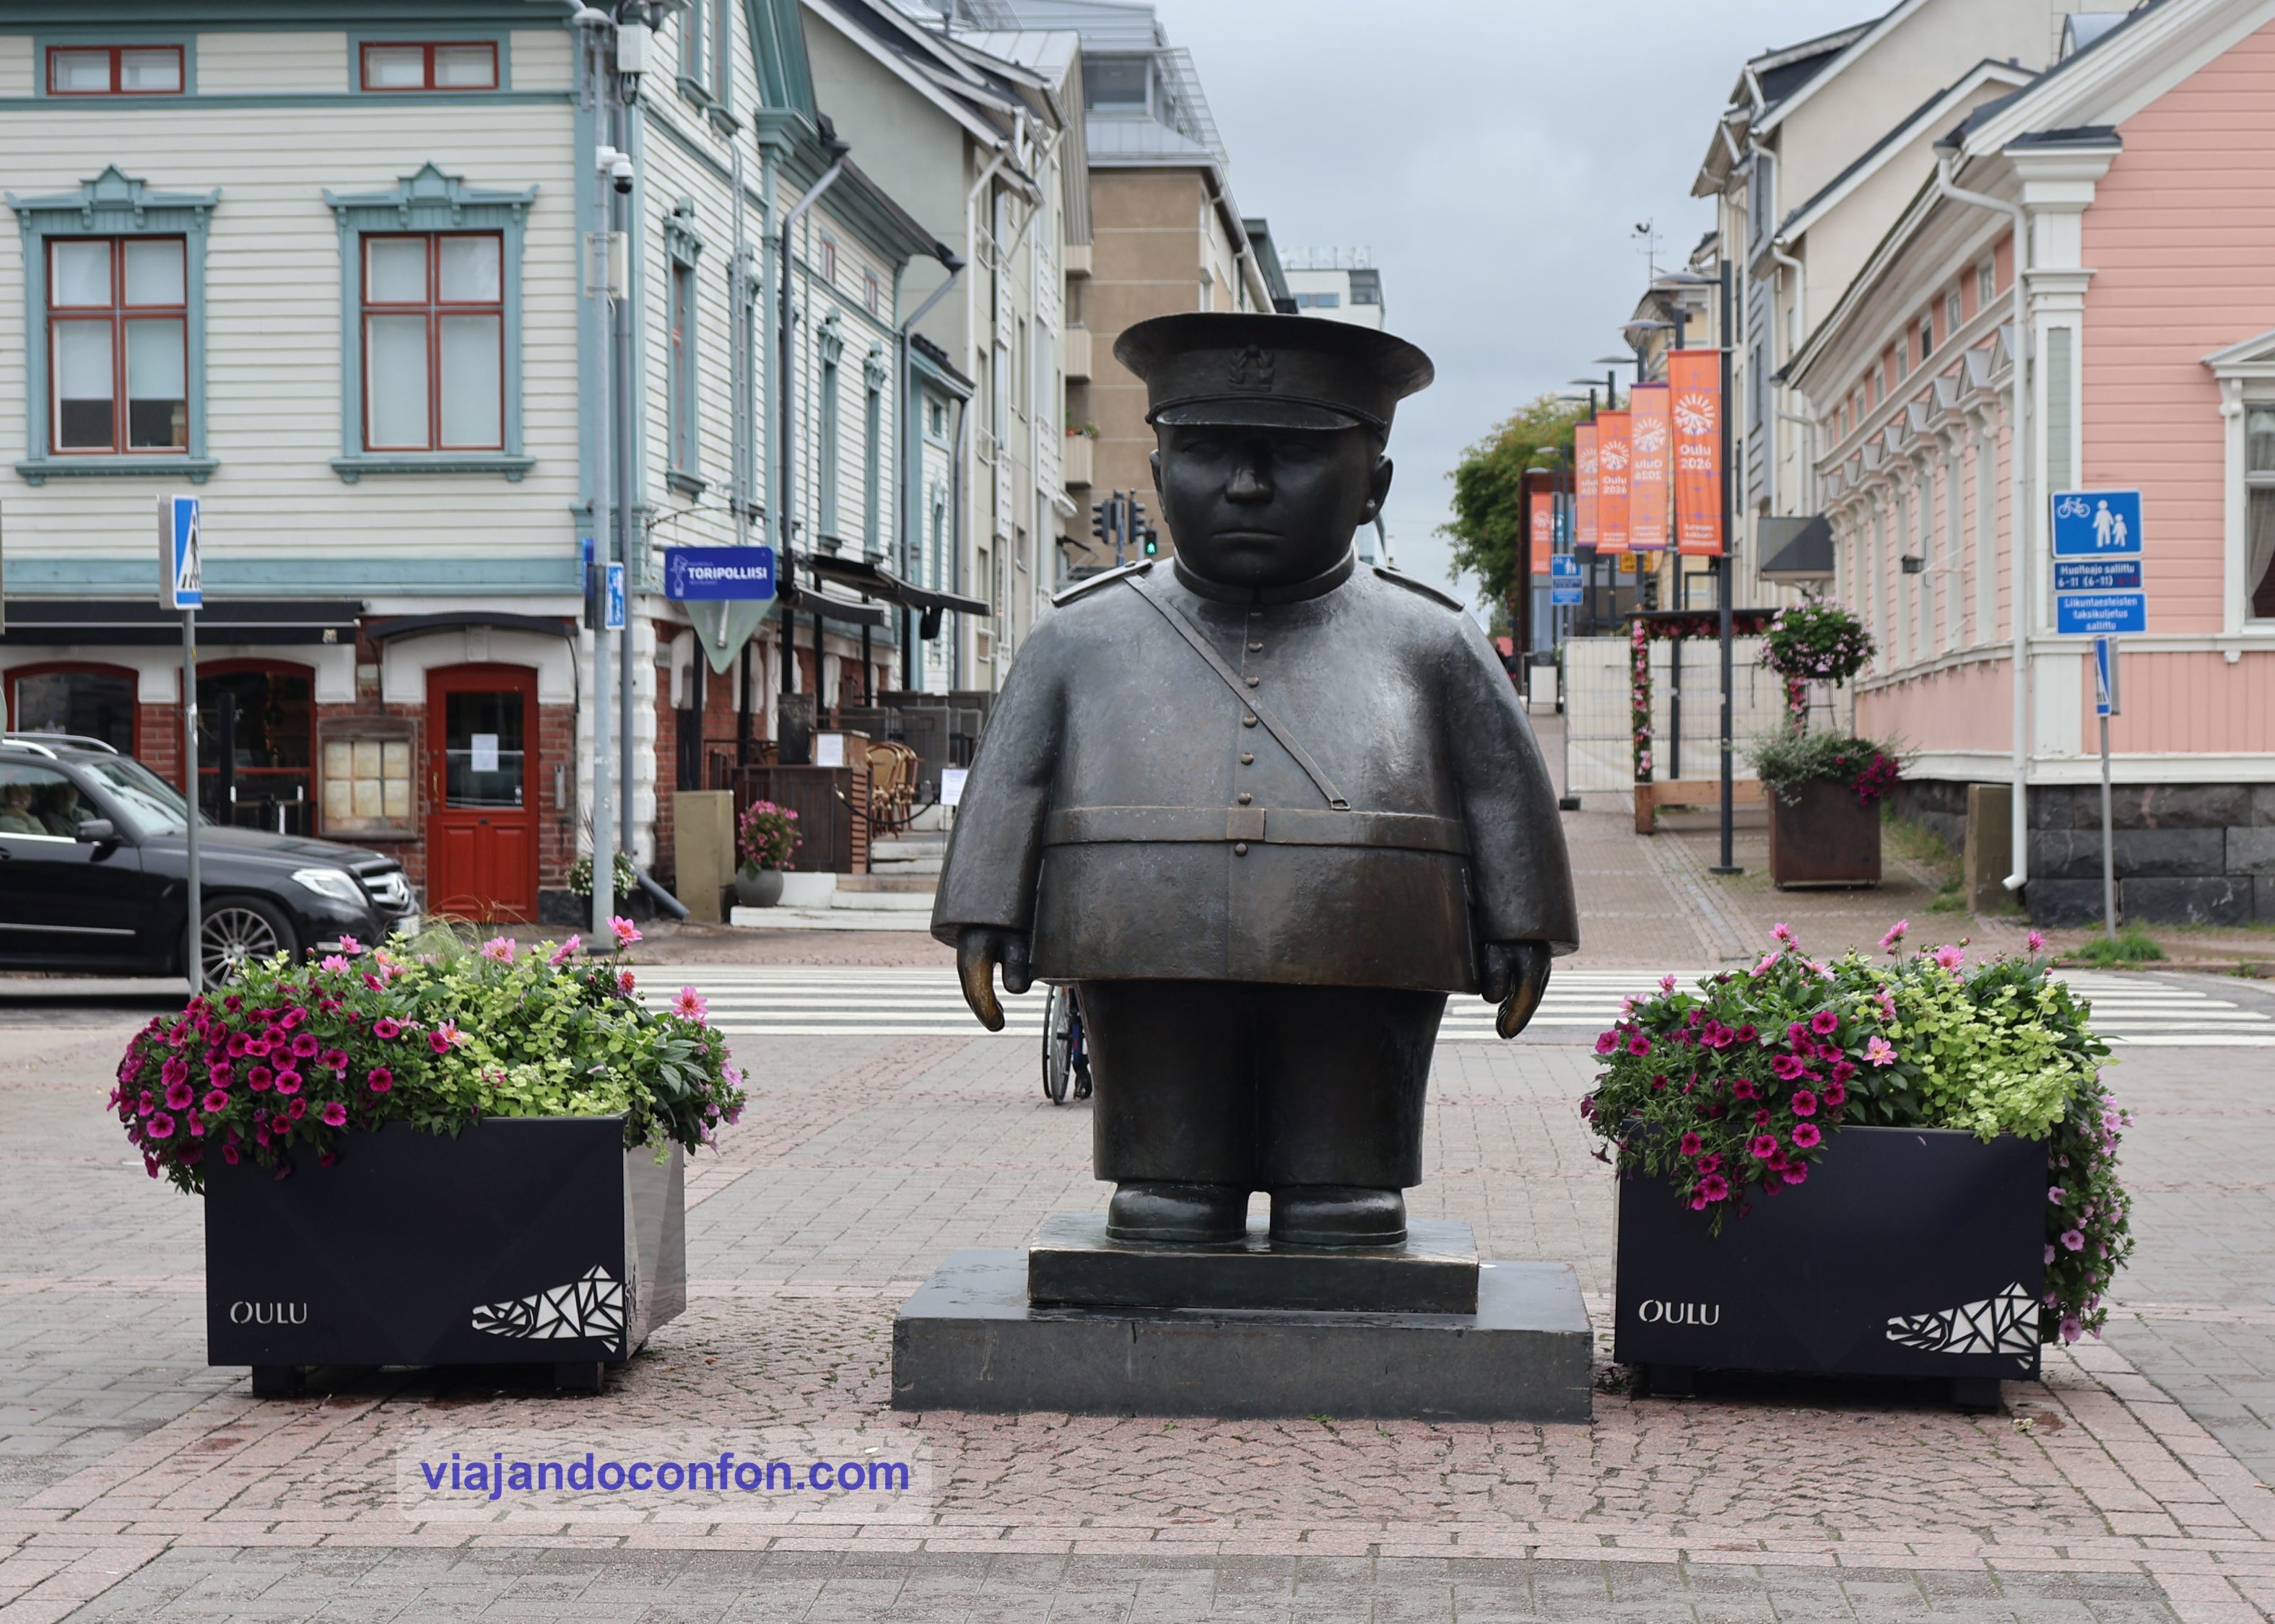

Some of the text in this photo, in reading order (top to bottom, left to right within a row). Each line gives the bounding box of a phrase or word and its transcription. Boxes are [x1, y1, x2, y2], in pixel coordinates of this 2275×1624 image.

[1680, 444, 1711, 455] Oulu
[1680, 458, 1712, 469] 2026
[1602, 476, 1627, 486] Oulu
[1602, 485, 1627, 495] 2026
[687, 567, 767, 580] TORIPOLLIISI
[2061, 563, 2134, 575] Huoltoajo sallittu
[2058, 577, 2079, 588] 6-11
[2083, 575, 2113, 588] (6-11)
[2065, 597, 2137, 608] Liikuntaesteisten
[2074, 609, 2128, 619] taksikuljetus
[2087, 621, 2116, 631] sallittu
[229, 1301, 308, 1324] OULU
[1638, 1299, 1720, 1326] OULU
